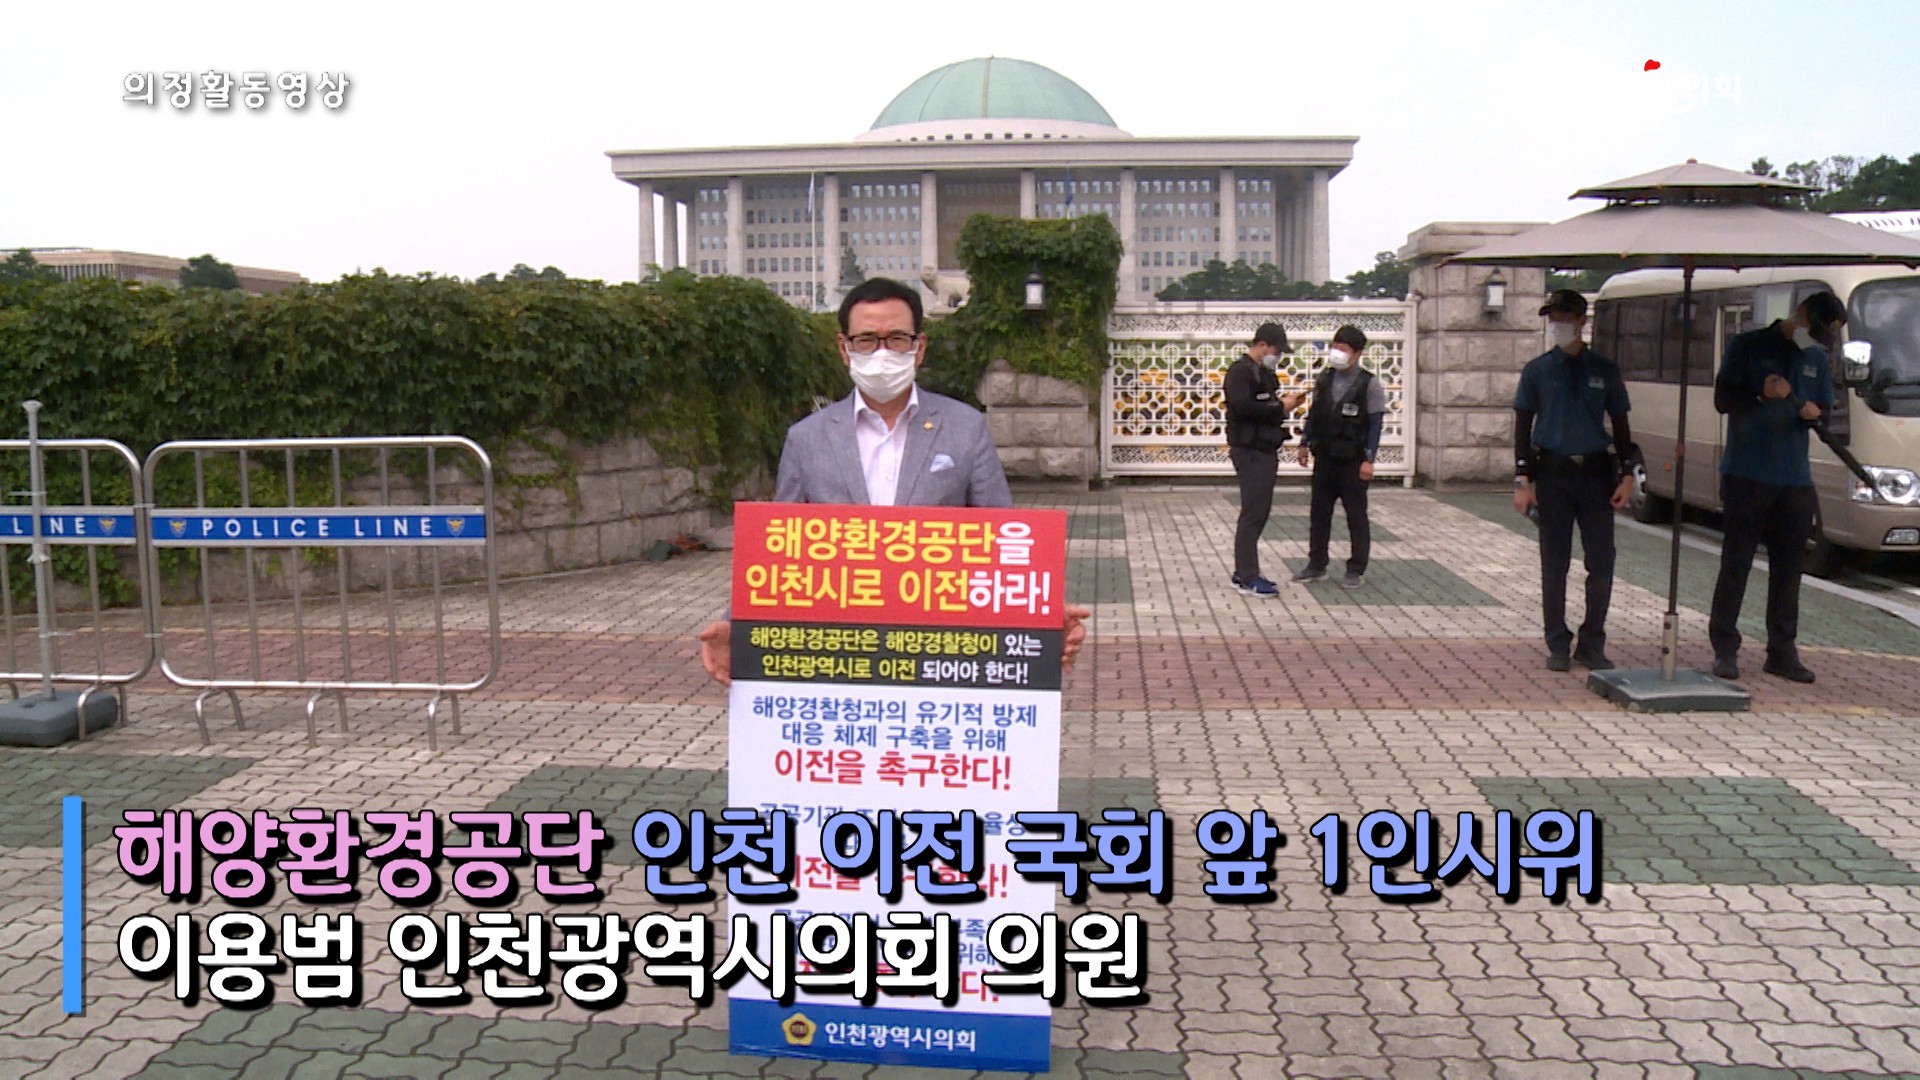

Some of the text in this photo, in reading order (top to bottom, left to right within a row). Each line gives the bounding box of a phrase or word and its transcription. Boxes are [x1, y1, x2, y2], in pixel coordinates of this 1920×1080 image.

[12, 516, 87, 535] LNE
[201, 517, 432, 537] POLICE LINE
[765, 516, 1035, 566] 해양환경공단을
[745, 564, 1050, 614] 인천시로 이전하라!
[750, 627, 1043, 657] 해양환경공단은 해양경찰청이 있는
[762, 655, 1029, 684] 인천광역시로 이전 되어야 한다!
[753, 695, 1038, 727] 해양경찰청과의 유기적 방제
[781, 722, 1007, 752] 대응 체제 구축을 위해
[775, 748, 1011, 791] 이전을 촉구한다!
[825, 1021, 976, 1052] 인천광역시의회
